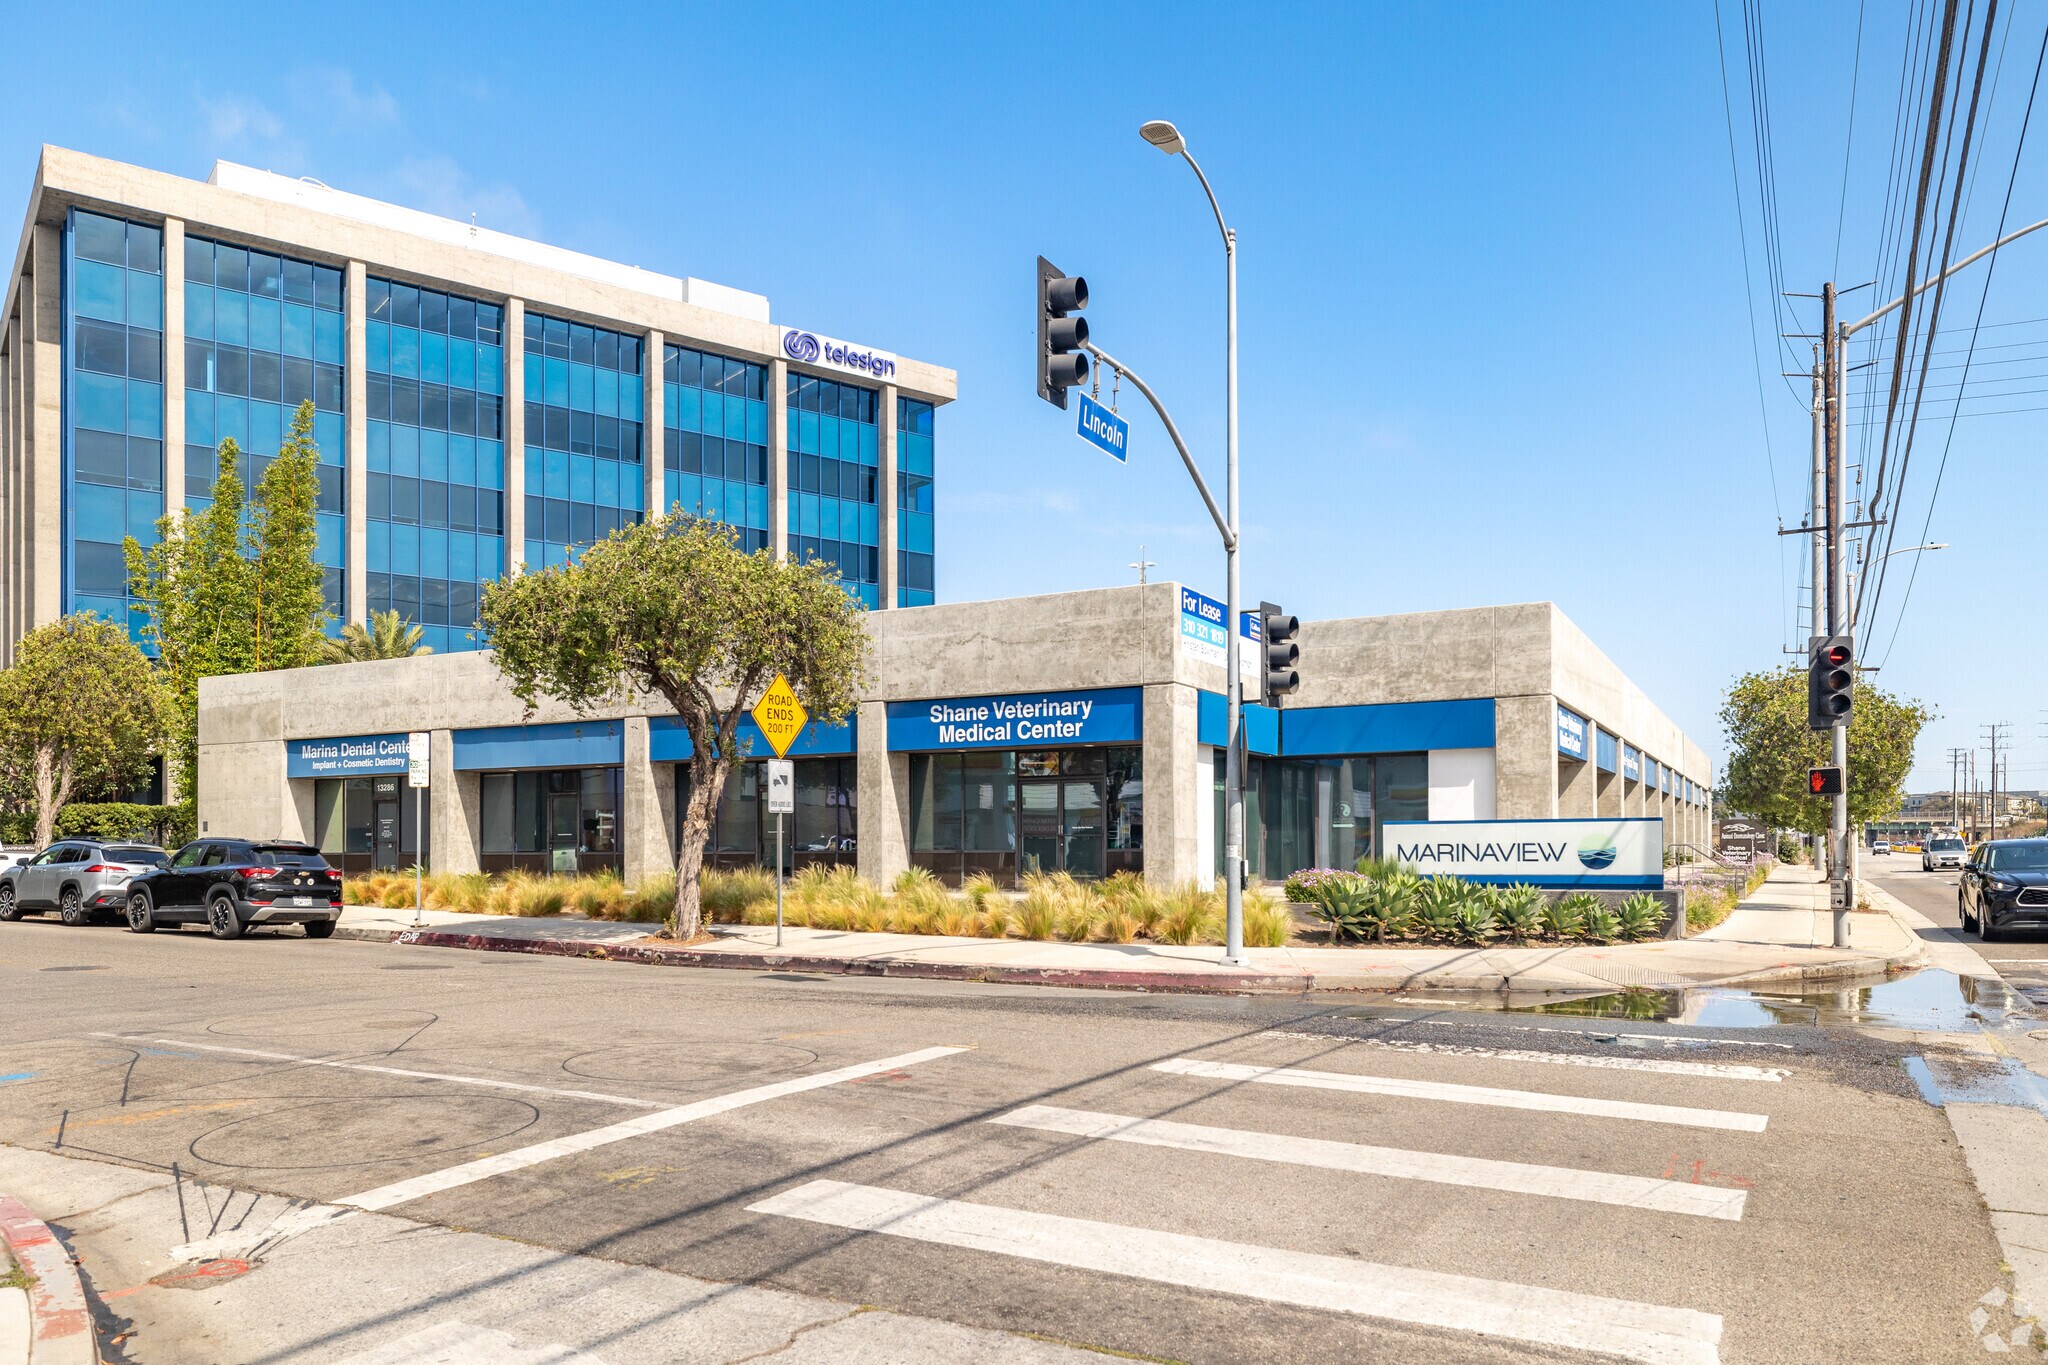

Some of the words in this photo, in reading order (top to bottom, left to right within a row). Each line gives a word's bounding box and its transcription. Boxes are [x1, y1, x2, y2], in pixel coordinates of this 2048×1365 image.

[824, 342, 896, 378] telesign
[1083, 405, 1123, 449] Lincoln
[1183, 591, 1197, 612] For
[1198, 597, 1221, 622] Lease
[1183, 618, 1196, 634] 310
[1196, 622, 1208, 639] 321
[1210, 628, 1224, 645] 1819
[768, 694, 792, 706] ROAD
[767, 708, 794, 721] ENDS
[930, 704, 989, 723] Shane
[992, 699, 1093, 720] Veterinary
[768, 723, 783, 733] 200
[785, 724, 793, 734] FT
[939, 722, 1011, 743] Medical
[1017, 720, 1084, 740] Center
[302, 744, 338, 759] Marina
[341, 741, 376, 757] Dental
[379, 740, 409, 755] Cente
[312, 760, 336, 770] Implant
[343, 759, 373, 768] Cosmetic
[375, 757, 405, 767] Dentistry
[1397, 842, 1567, 862] MARINAVIEW
